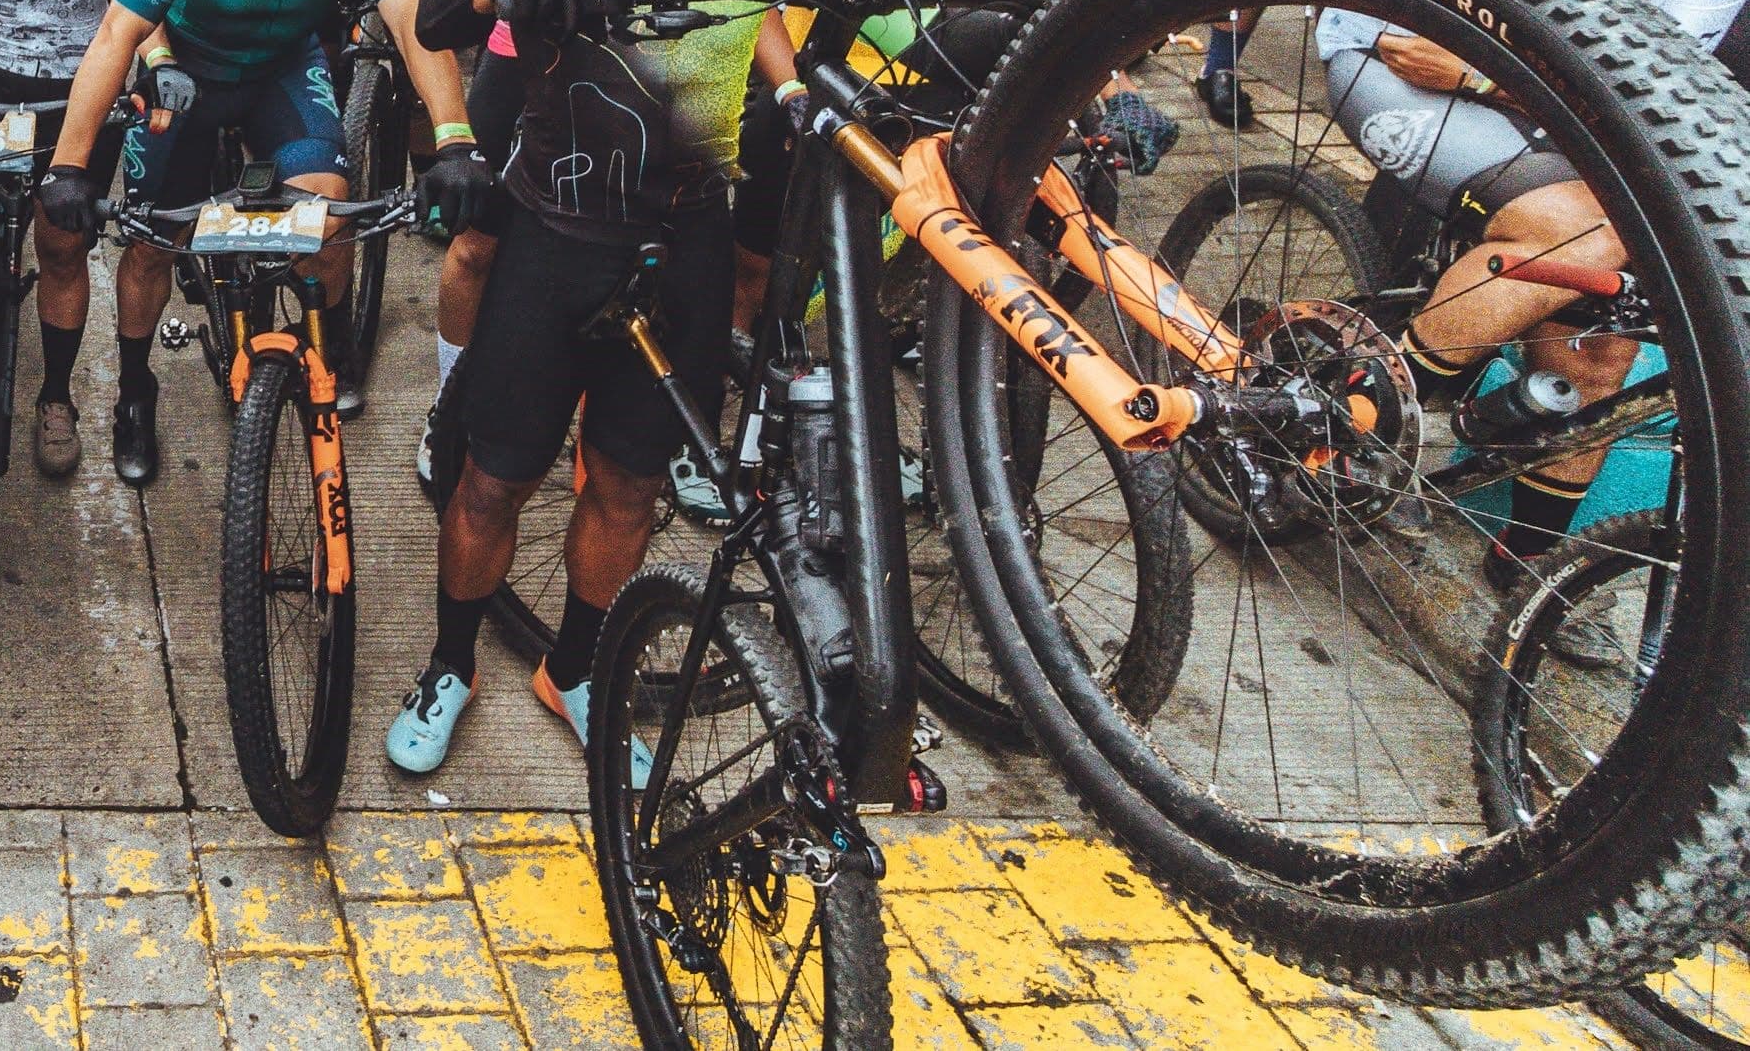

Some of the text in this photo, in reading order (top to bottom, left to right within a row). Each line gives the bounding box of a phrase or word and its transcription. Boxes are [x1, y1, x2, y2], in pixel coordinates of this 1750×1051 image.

[227, 216, 292, 237] 284
[1001, 290, 1099, 378] FOX
[328, 482, 348, 538] FOX
